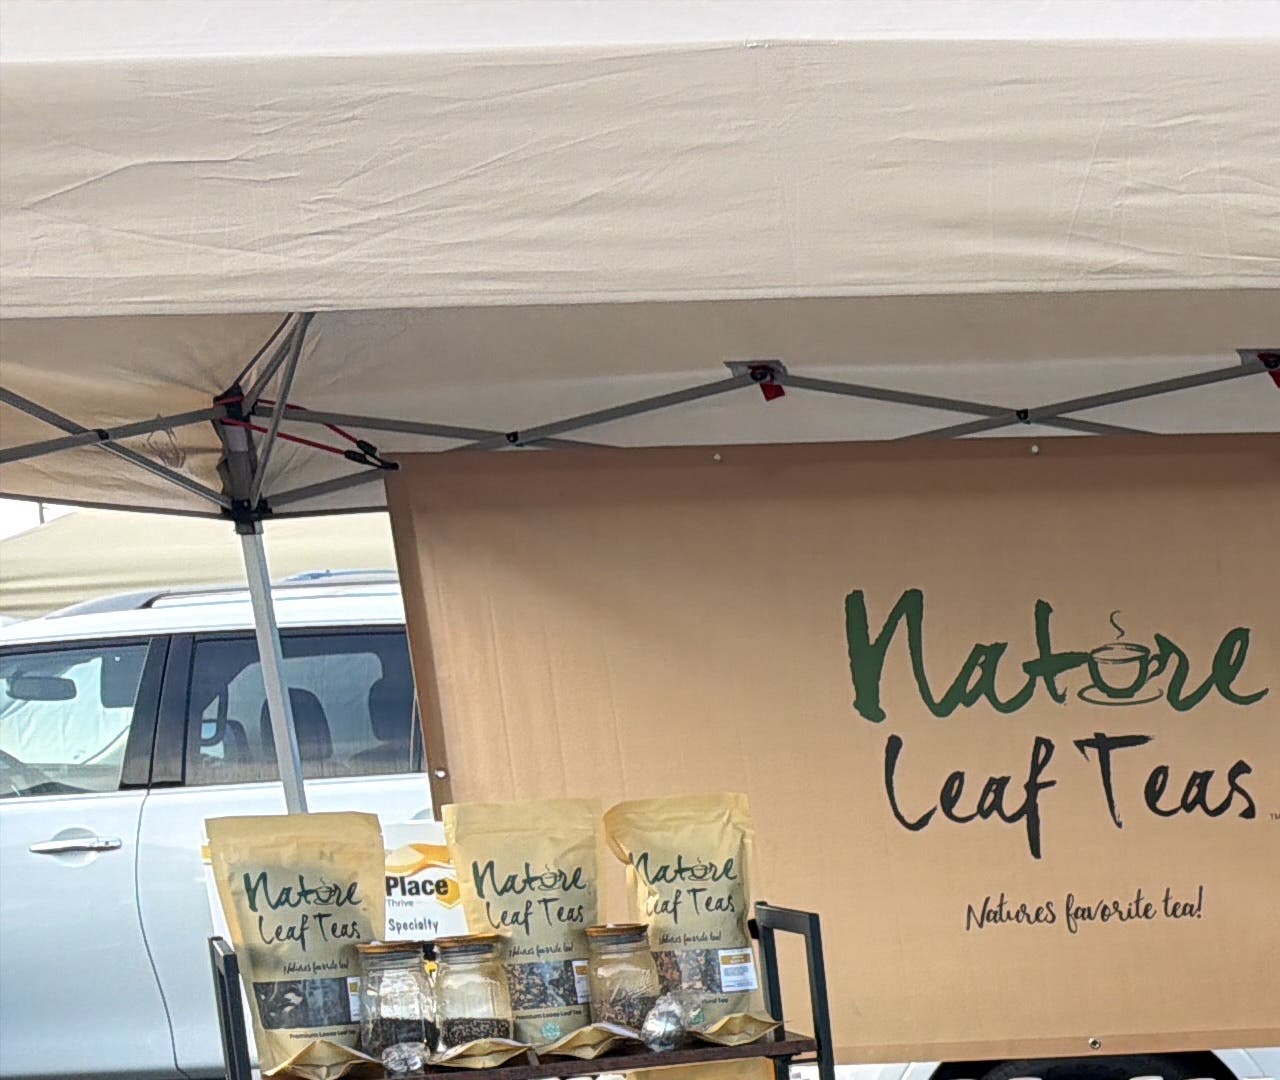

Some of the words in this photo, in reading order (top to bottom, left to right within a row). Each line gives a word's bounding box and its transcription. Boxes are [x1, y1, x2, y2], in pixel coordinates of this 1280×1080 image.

[844, 589, 1269, 723] Nature
[884, 733, 1057, 859] Leaf
[1074, 731, 1257, 829] Teas
[243, 872, 362, 913] Nature
[385, 876, 448, 896] Place
[472, 861, 587, 898] Nature
[486, 900, 533, 935] Leaf
[537, 898, 584, 925] Teas
[687, 888, 735, 916] Teas
[966, 895, 1057, 931] Natures
[1066, 888, 1157, 934] favorite
[1163, 886, 1203, 919] tea!
[259, 914, 309, 951] Leaf
[314, 913, 361, 941] Teas
[389, 918, 438, 934] Specialty
